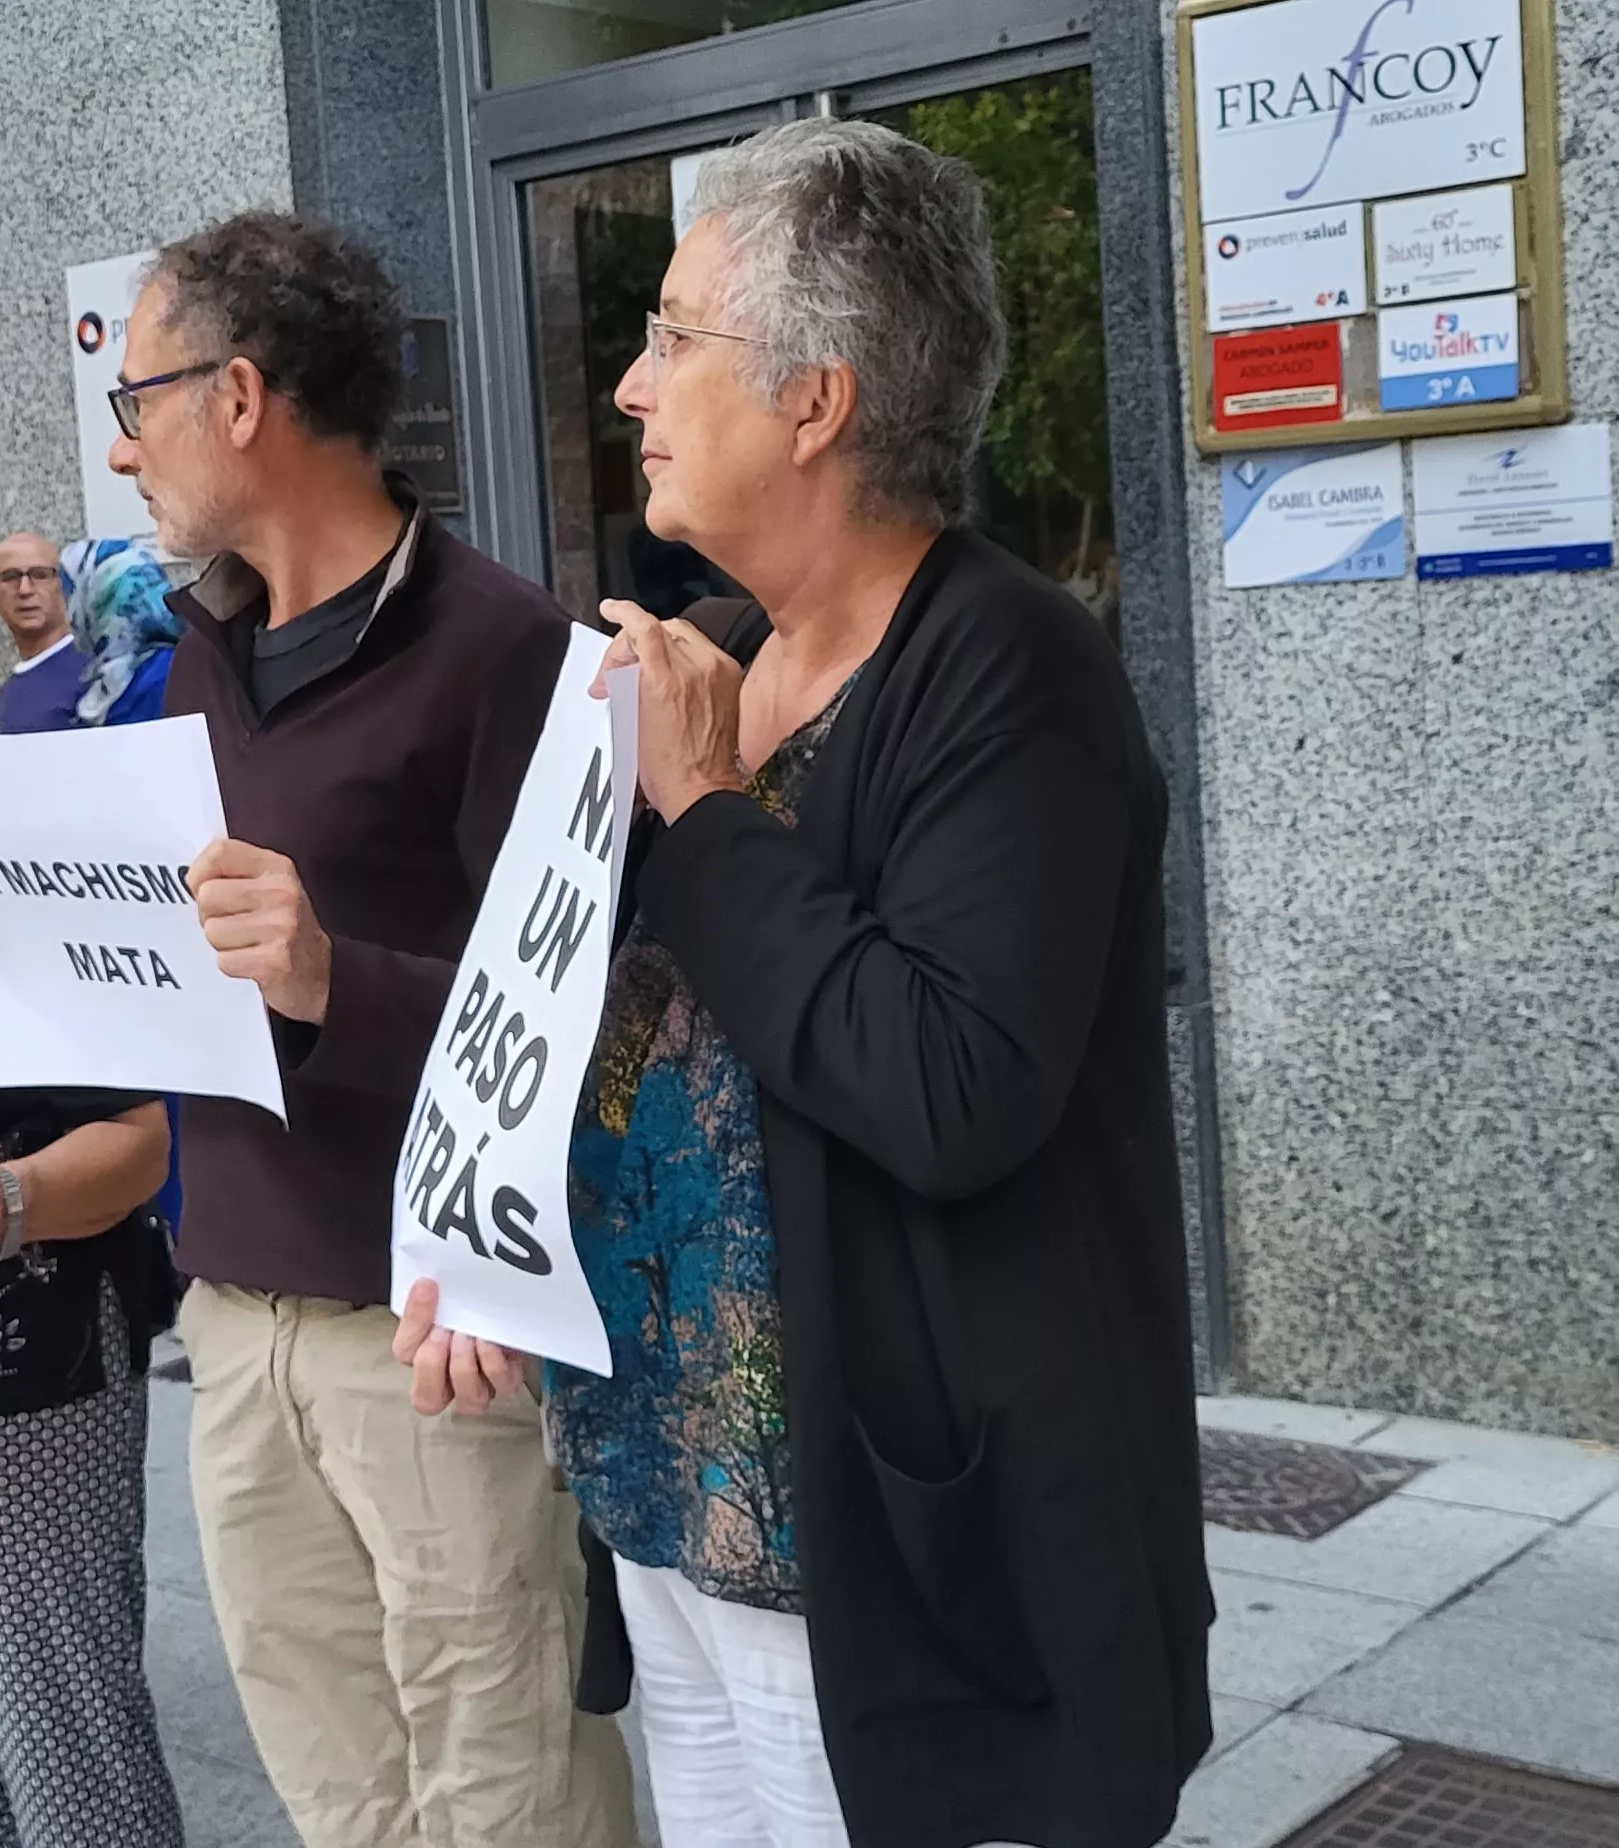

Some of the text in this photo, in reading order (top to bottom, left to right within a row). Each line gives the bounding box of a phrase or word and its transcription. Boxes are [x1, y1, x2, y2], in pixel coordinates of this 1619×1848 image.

[1368, 102, 1456, 127] ABOGADOS
[1268, 490, 1313, 511] ISABEL
[518, 864, 597, 994] UN
[63, 942, 183, 991] MATA
[446, 967, 548, 1131] PASO
